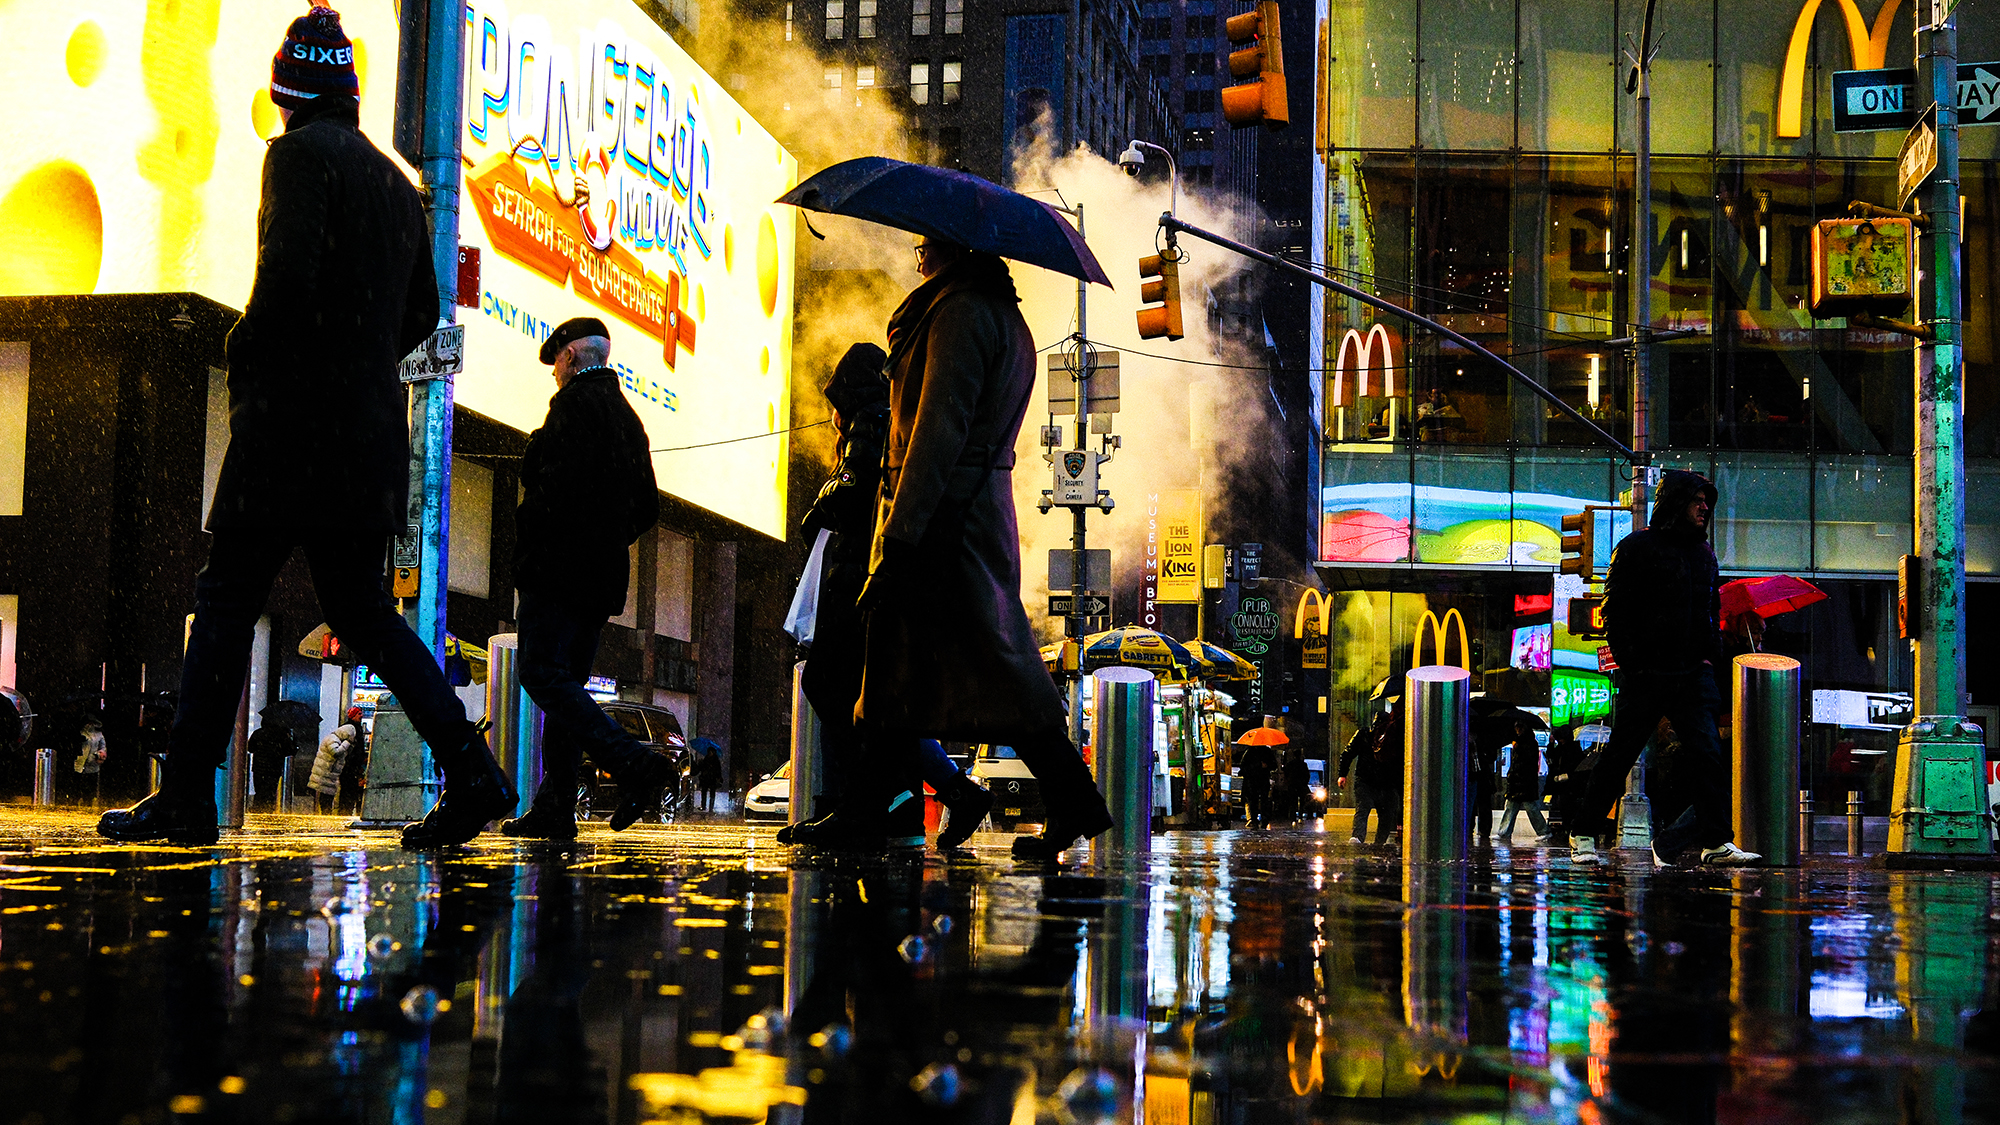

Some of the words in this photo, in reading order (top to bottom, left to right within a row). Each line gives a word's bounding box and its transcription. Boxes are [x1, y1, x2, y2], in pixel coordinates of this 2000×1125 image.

[1861, 86, 1914, 112] ONE
[1957, 81, 2000, 106] AY
[493, 180, 554, 252] SEARCH
[557, 227, 574, 262] FOR
[579, 243, 663, 325] SQUAREPANTS
[484, 291, 518, 329] ONLY
[522, 311, 536, 340] IN
[541, 321, 555, 344] TH
[441, 329, 463, 349] ZONE
[399, 360, 417, 377] ING
[1146, 493, 1158, 569] MUSEUM
[1169, 526, 1189, 536] THE
[1165, 540, 1192, 557] LION
[1162, 559, 1196, 578] KING
[1145, 588, 1156, 630] BRO
[1246, 601, 1268, 612] PUB
[1233, 614, 1277, 628] CONNOLLY'S
[1123, 651, 1169, 662] SABRETT
